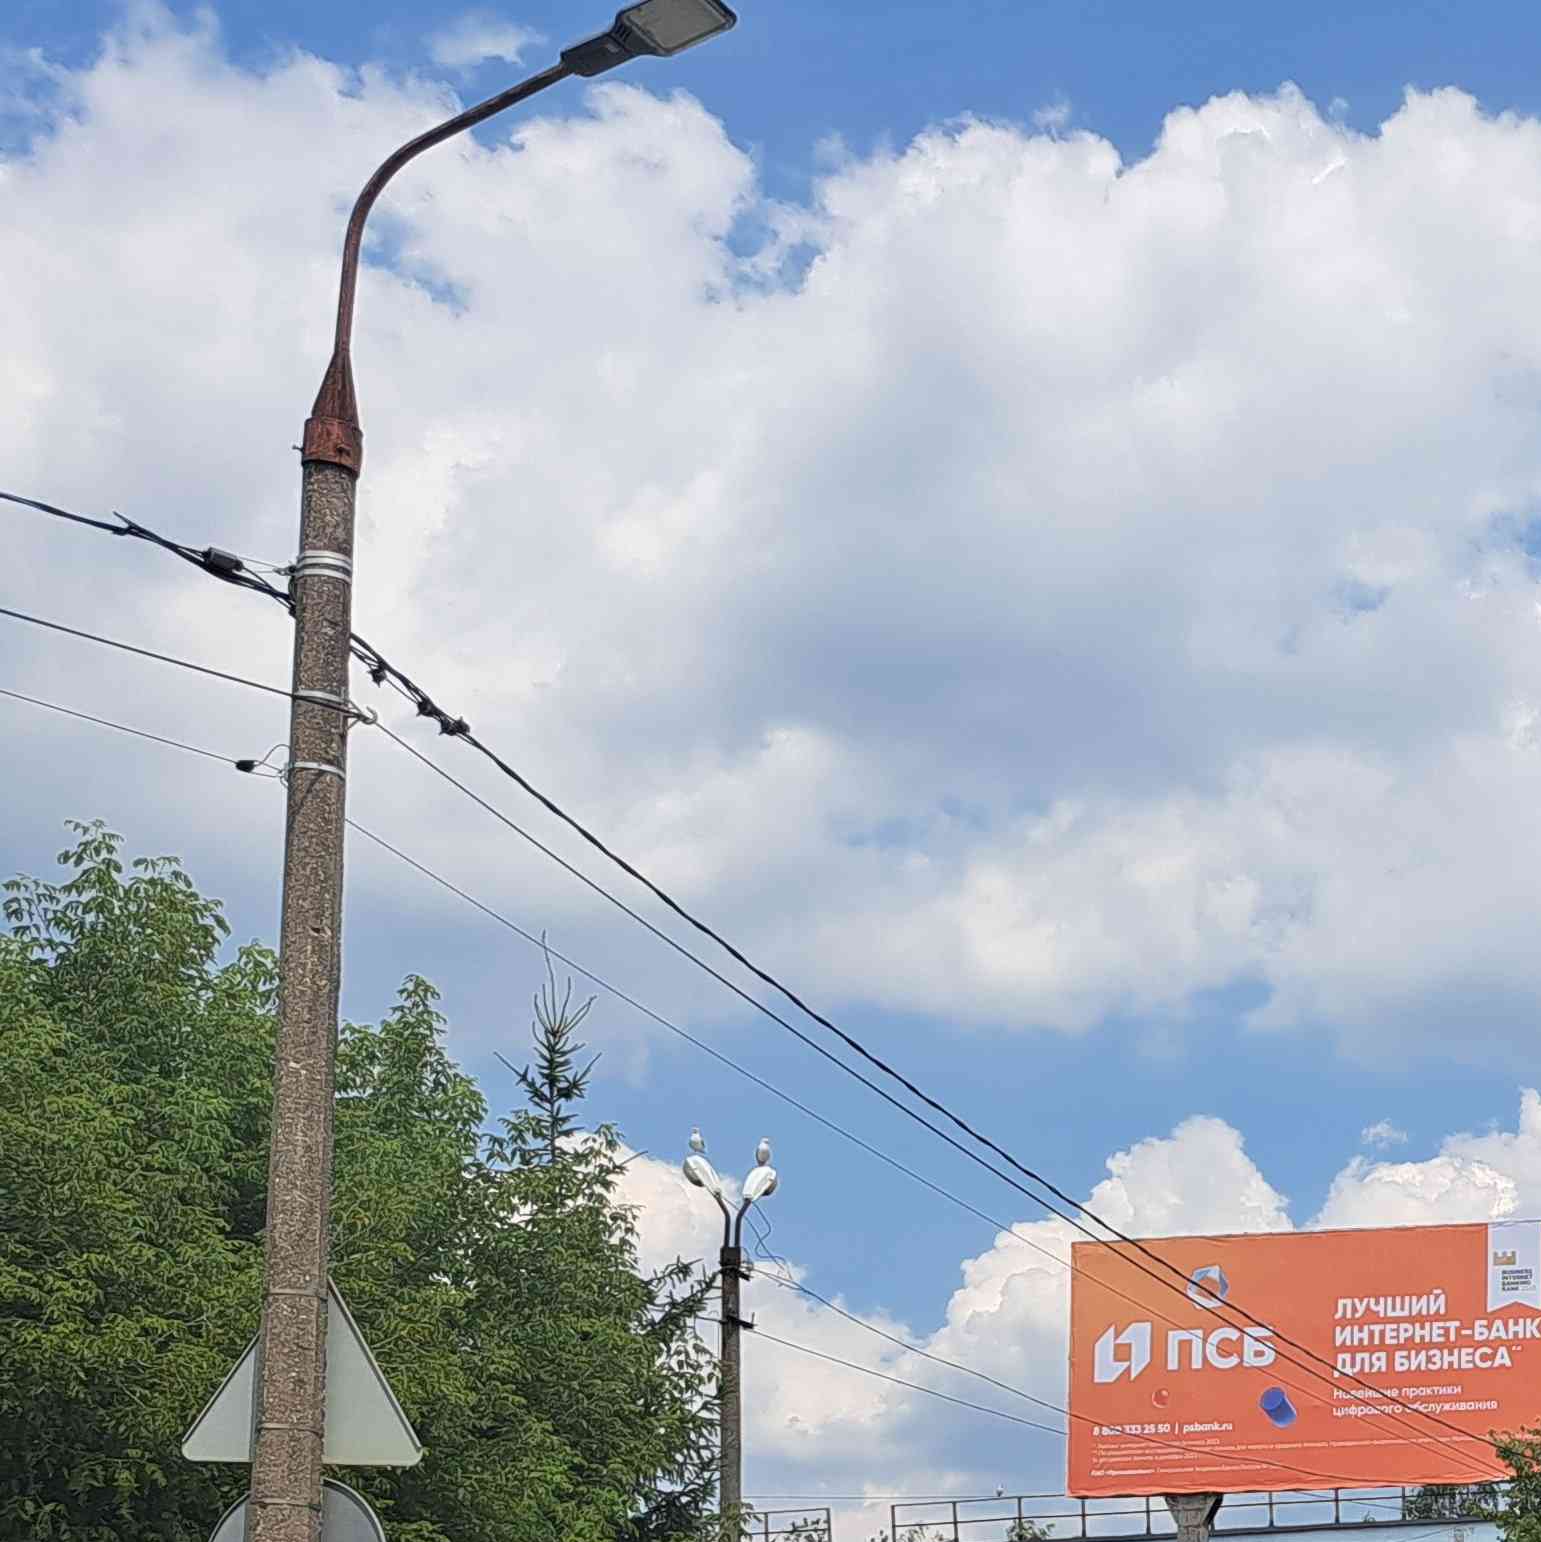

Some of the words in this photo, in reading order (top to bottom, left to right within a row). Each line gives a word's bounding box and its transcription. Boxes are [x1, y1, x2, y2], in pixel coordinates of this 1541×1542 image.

[1334, 1288, 1446, 1319] ЛУЧШИЙ
[1167, 1326, 1276, 1371] ПСБ
[1333, 1351, 1387, 1378] ДЛЯ
[1402, 1384, 1462, 1399] практики
[1405, 1400, 1498, 1416] обслуживания
[1157, 1423, 1171, 1433] 50
[1183, 1421, 1233, 1434] psbank.ru
